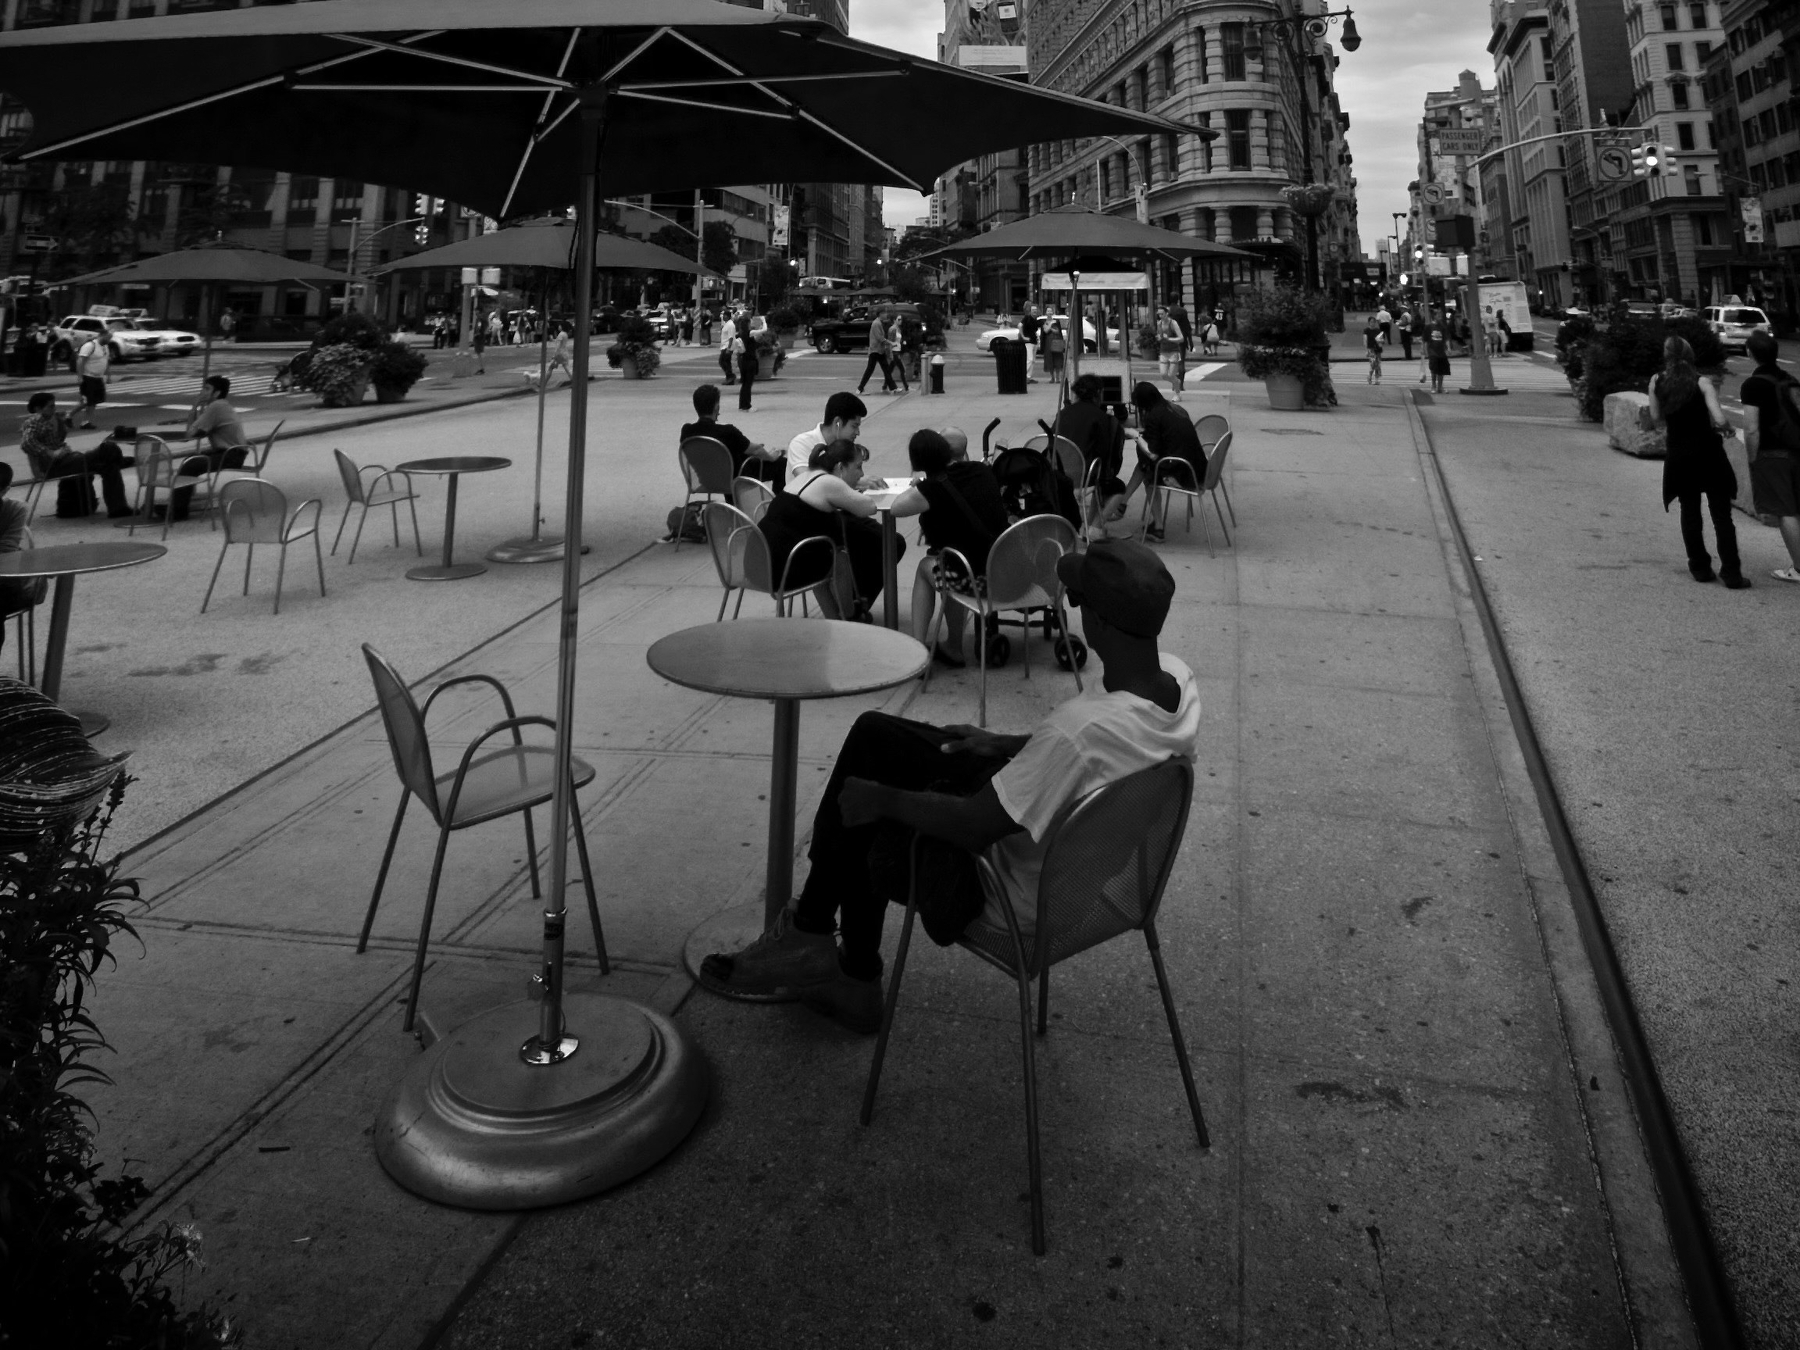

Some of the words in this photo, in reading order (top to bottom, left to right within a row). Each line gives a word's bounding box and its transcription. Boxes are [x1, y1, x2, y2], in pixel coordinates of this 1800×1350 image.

[1442, 132, 1478, 140] PASSENGER
[1442, 142, 1459, 151] CARS
[1463, 142, 1479, 151] ONLY
